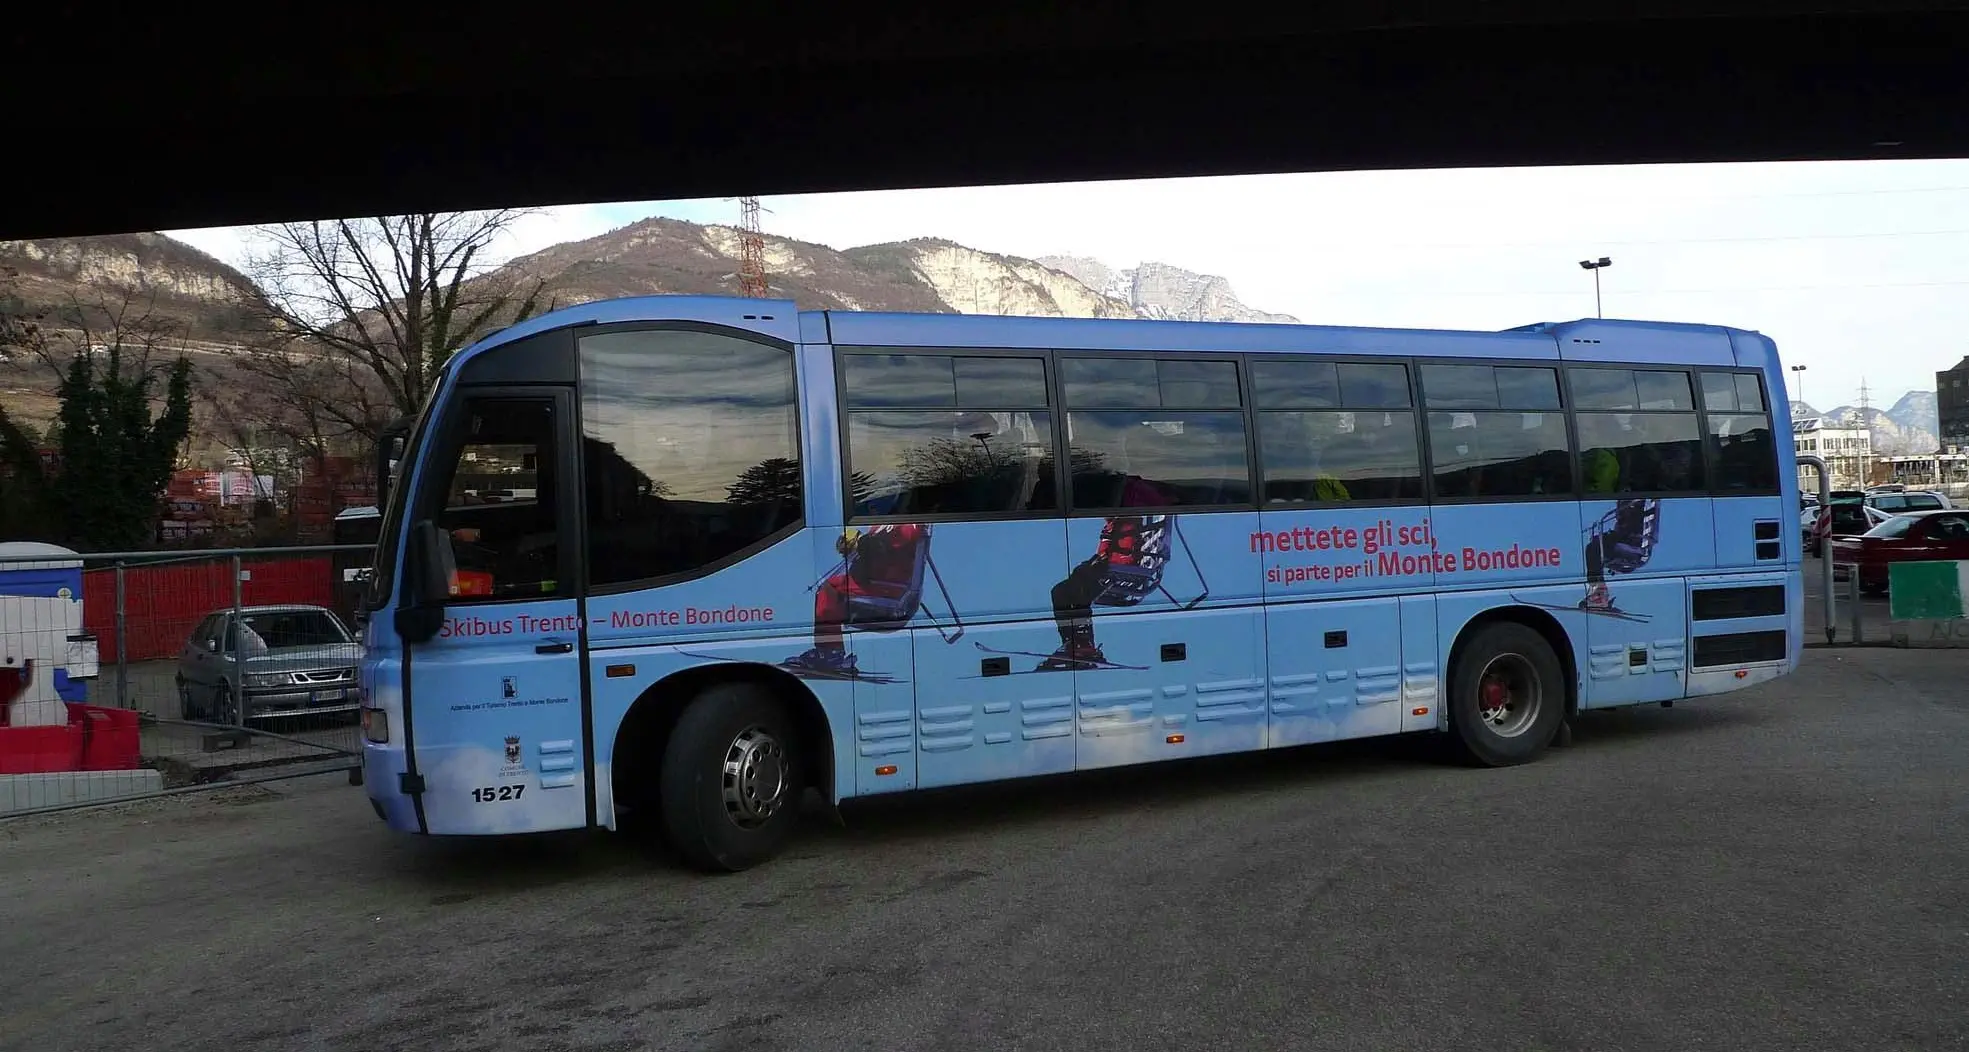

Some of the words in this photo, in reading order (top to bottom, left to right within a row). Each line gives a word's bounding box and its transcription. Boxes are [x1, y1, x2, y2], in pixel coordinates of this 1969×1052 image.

[1250, 526, 1358, 552] mettete
[1363, 520, 1393, 555] gli
[1398, 518, 1437, 550] sci,
[1267, 564, 1281, 582] si
[1284, 564, 1330, 586] parte
[1334, 564, 1361, 583] per
[1364, 560, 1373, 577] il
[1378, 550, 1457, 576] Monte
[1462, 543, 1561, 571] Bondone
[440, 617, 513, 638] Skibus
[611, 609, 680, 629] Monte
[685, 603, 774, 625] Bondone
[471, 784, 526, 803] 1527
